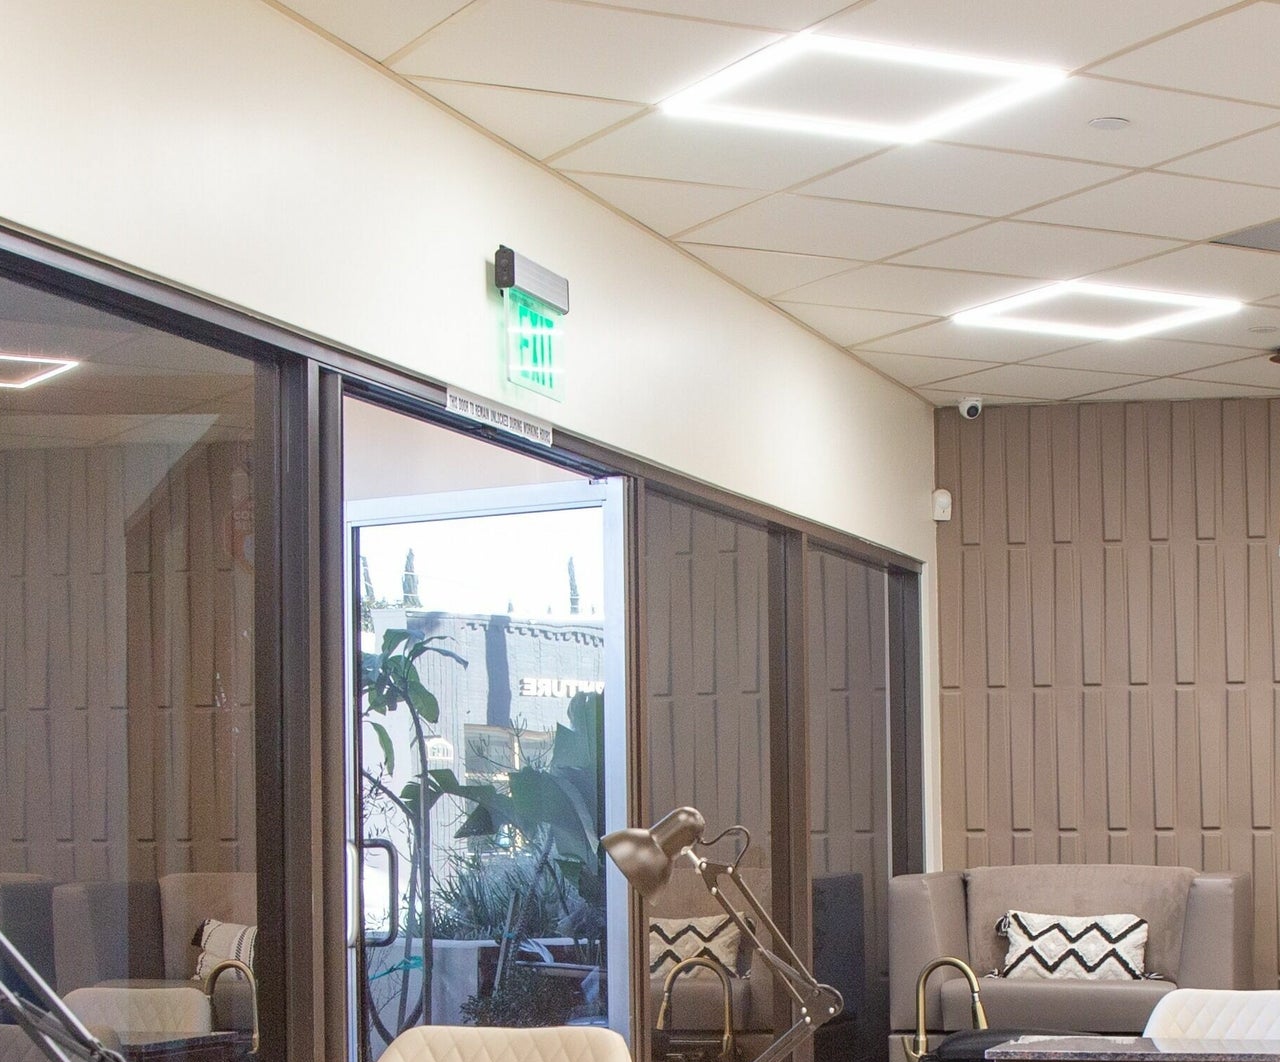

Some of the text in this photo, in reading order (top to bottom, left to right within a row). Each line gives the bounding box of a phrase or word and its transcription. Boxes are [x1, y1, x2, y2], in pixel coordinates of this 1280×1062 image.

[518, 303, 554, 389] EXIT
[458, 397, 469, 413] DOOR
[475, 404, 490, 421] REMAIN
[491, 410, 509, 428] UNLOCKED
[509, 416, 522, 433] DURING
[523, 422, 539, 439] WORKING
